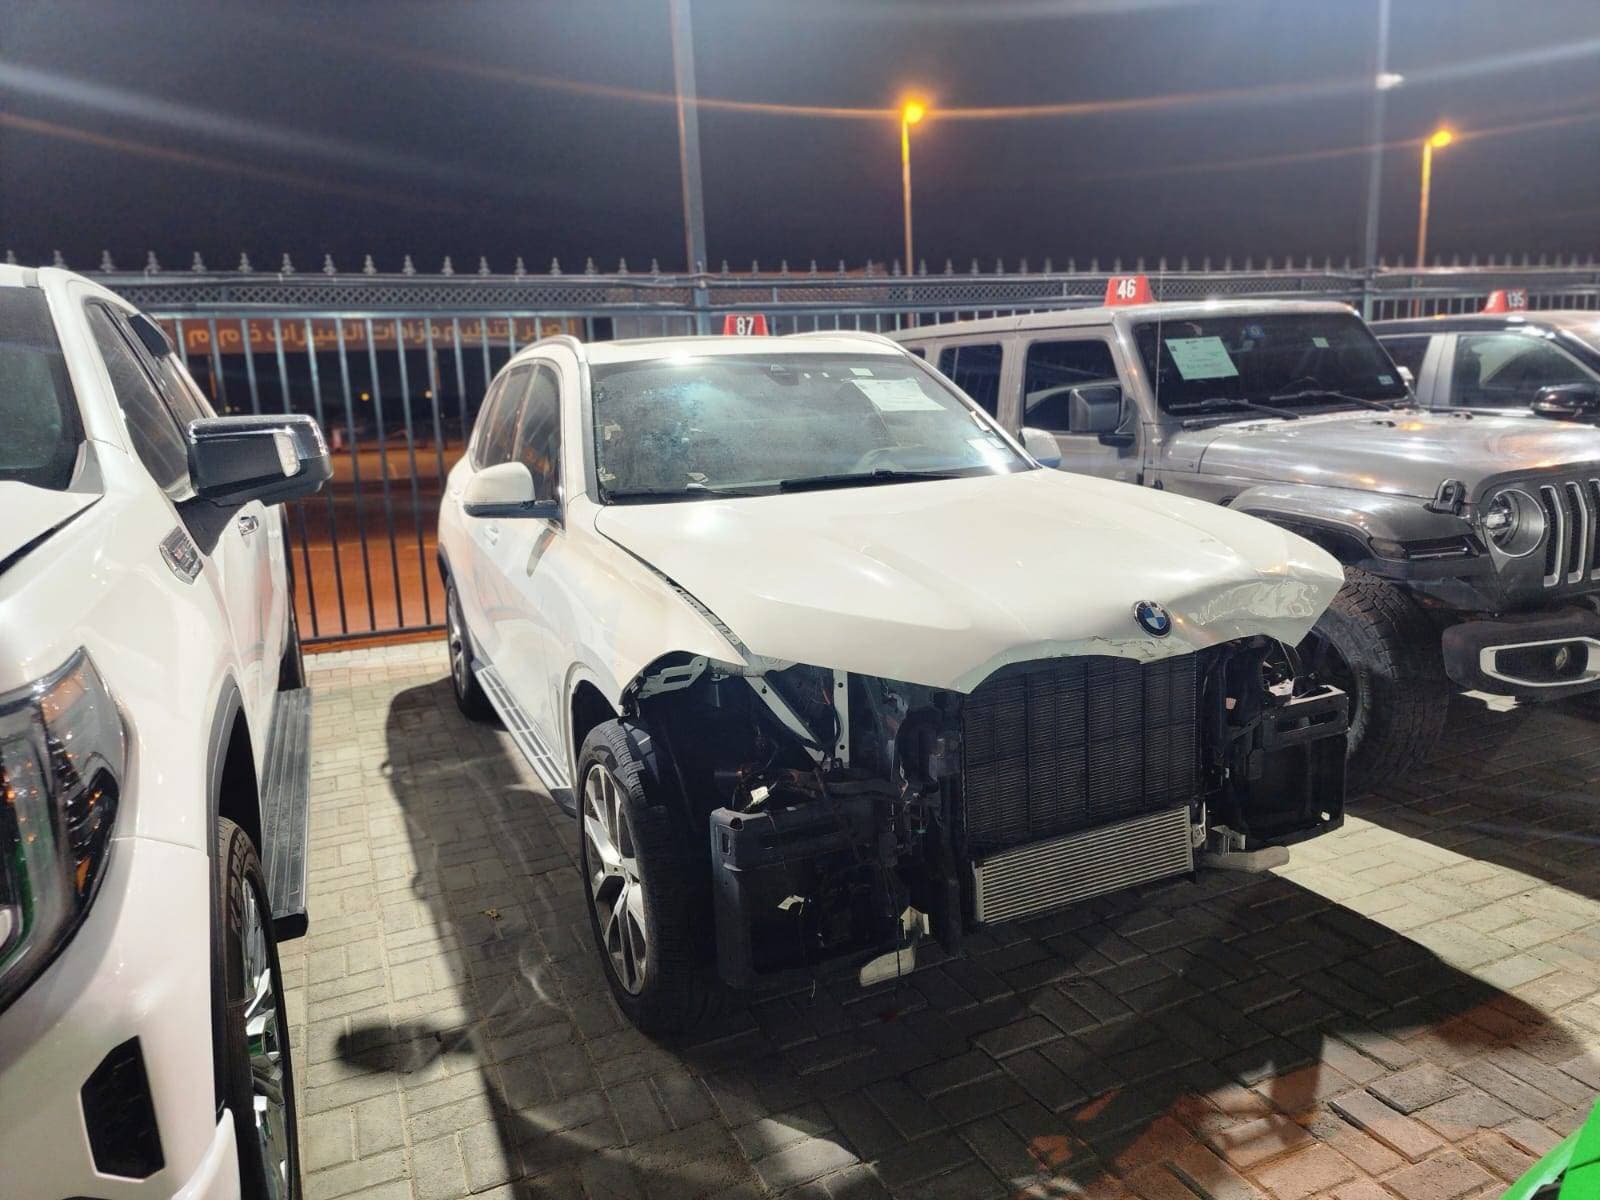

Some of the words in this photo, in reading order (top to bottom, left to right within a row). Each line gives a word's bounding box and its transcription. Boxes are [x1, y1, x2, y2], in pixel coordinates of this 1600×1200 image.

[1117, 279, 1136, 299] 46
[266, 322, 364, 346] السيرات
[736, 317, 754, 336] 87
[188, 329, 209, 348] م
[219, 329, 240, 347] م
